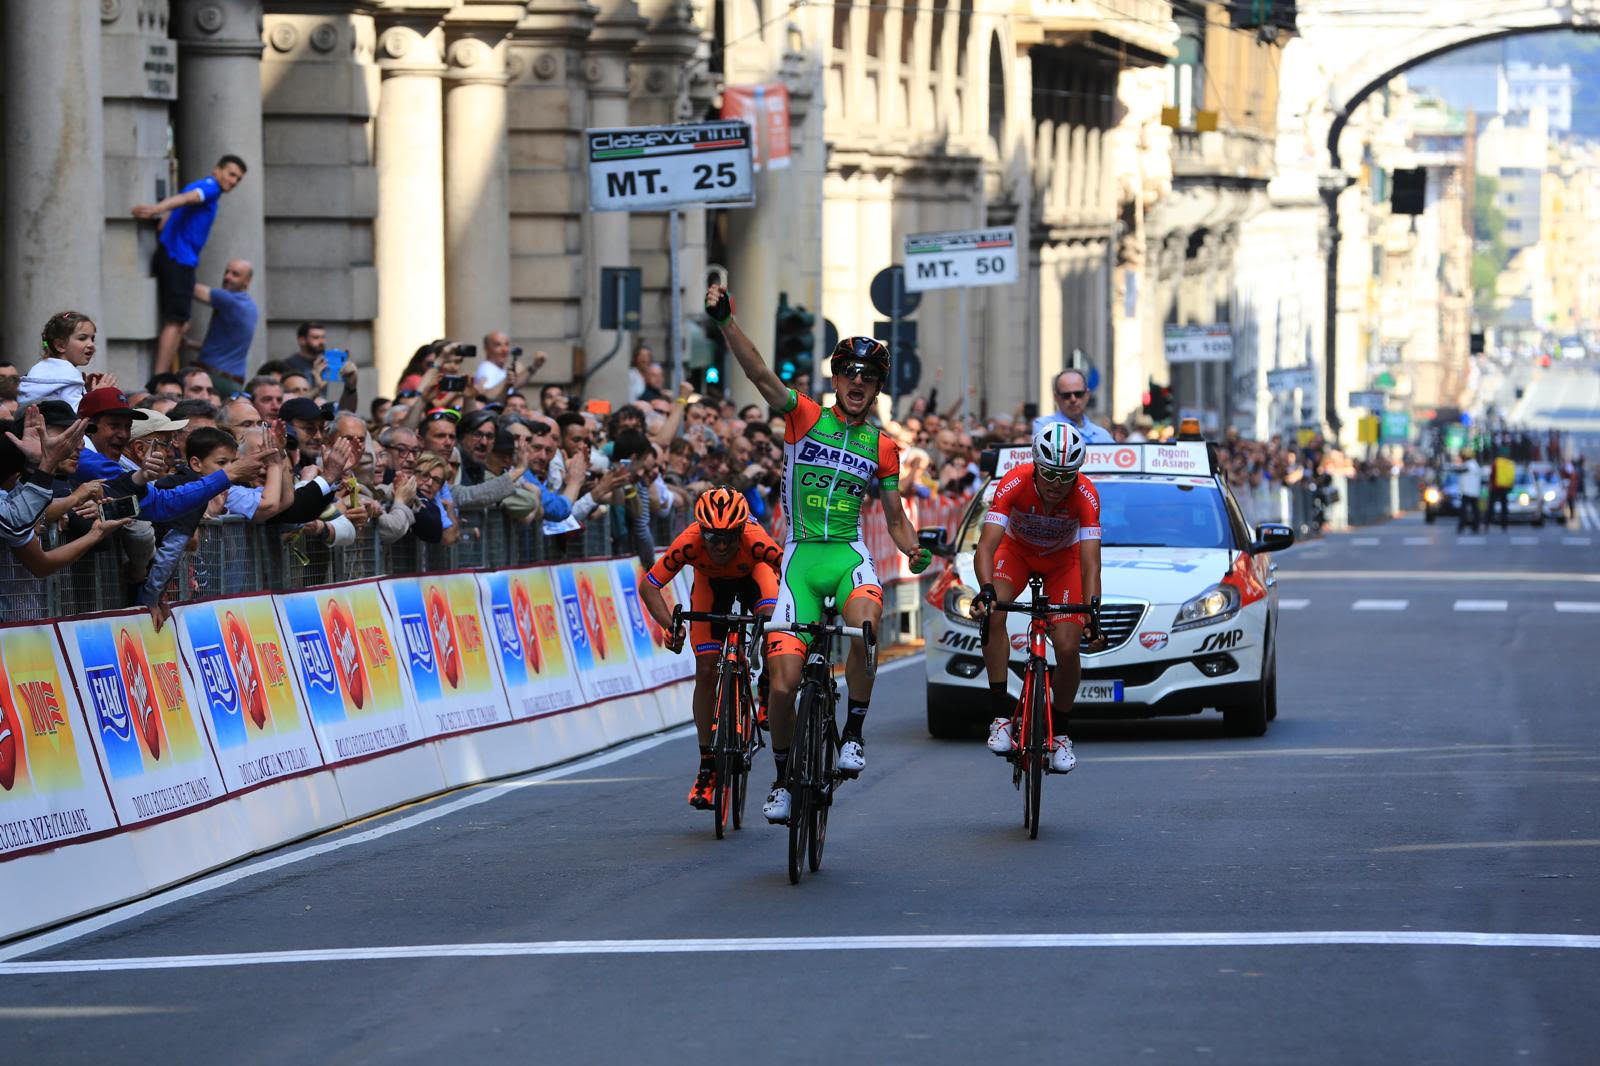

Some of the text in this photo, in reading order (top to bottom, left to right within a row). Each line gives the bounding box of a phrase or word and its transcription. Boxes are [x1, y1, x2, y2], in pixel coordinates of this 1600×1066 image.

[607, 162, 737, 198] MT. 25
[916, 256, 1005, 279] MT. 50
[1152, 458, 1196, 470] di Asiago
[1157, 447, 1190, 460] Rigoni
[663, 543, 697, 572] CCC
[1141, 632, 1167, 642] SMP
[1193, 629, 1243, 653] SMP
